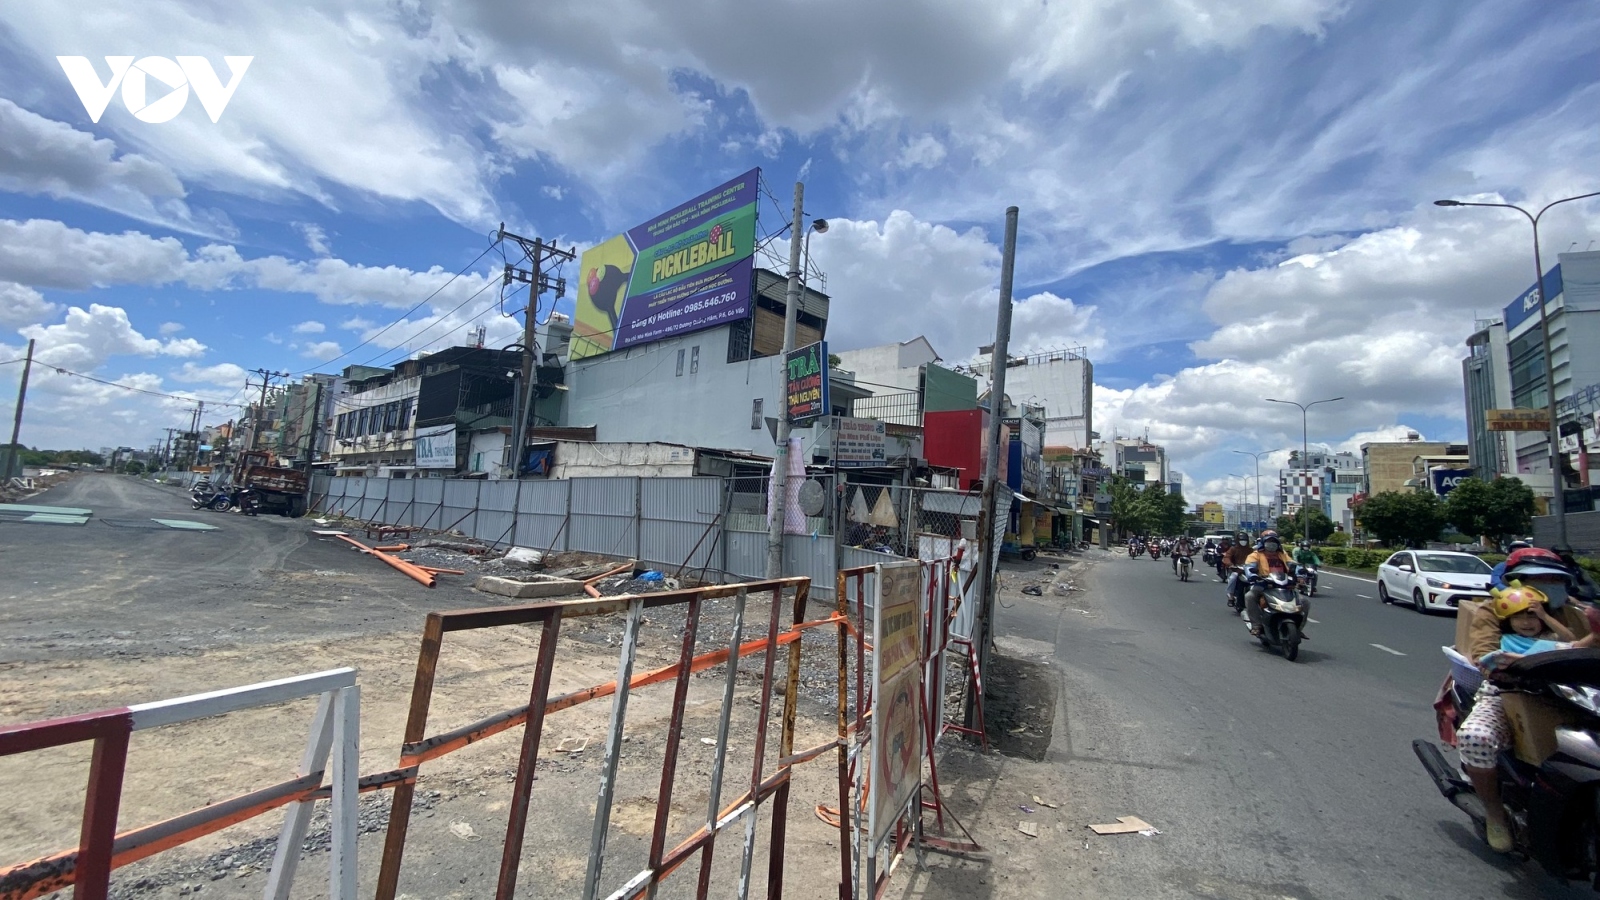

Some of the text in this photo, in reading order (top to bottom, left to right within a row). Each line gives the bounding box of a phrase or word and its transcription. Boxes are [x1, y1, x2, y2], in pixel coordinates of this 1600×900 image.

[669, 205, 697, 222] PICKLEBALL
[697, 192, 722, 209] TRAINING
[722, 182, 745, 198] CENTER
[710, 196, 736, 211] PICKLEBALL
[652, 230, 735, 284] PICKLEBALL
[657, 307, 683, 322] Hotline:
[684, 291, 737, 314] 0985.646.760
[1523, 288, 1540, 313] ACB
[1492, 421, 1523, 429] THANH
[1441, 476, 1470, 487] AC
